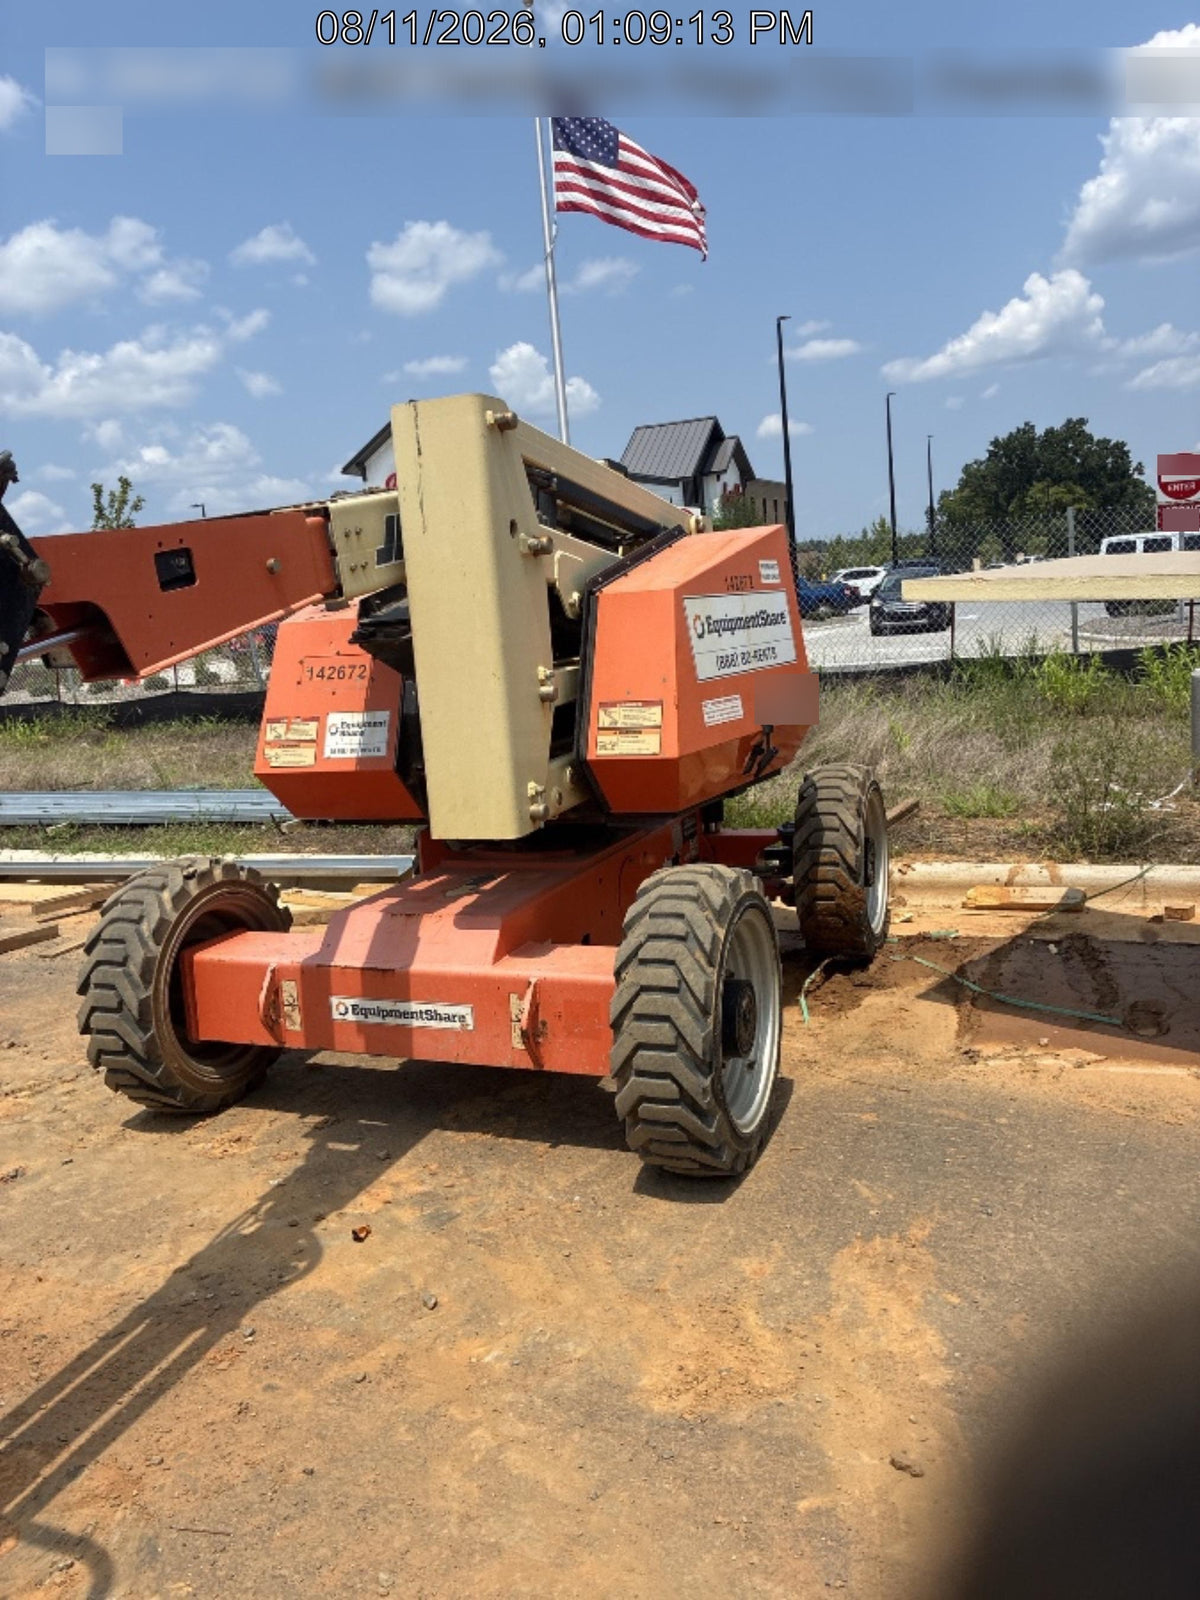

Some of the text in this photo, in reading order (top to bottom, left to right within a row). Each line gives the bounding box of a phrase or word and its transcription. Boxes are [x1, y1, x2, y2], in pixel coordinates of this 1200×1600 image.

[1167, 481, 1196, 492] ENTER
[705, 609, 787, 637] EquipmentShare
[306, 664, 367, 680] 142672
[350, 1003, 468, 1024] EquipmentShare
